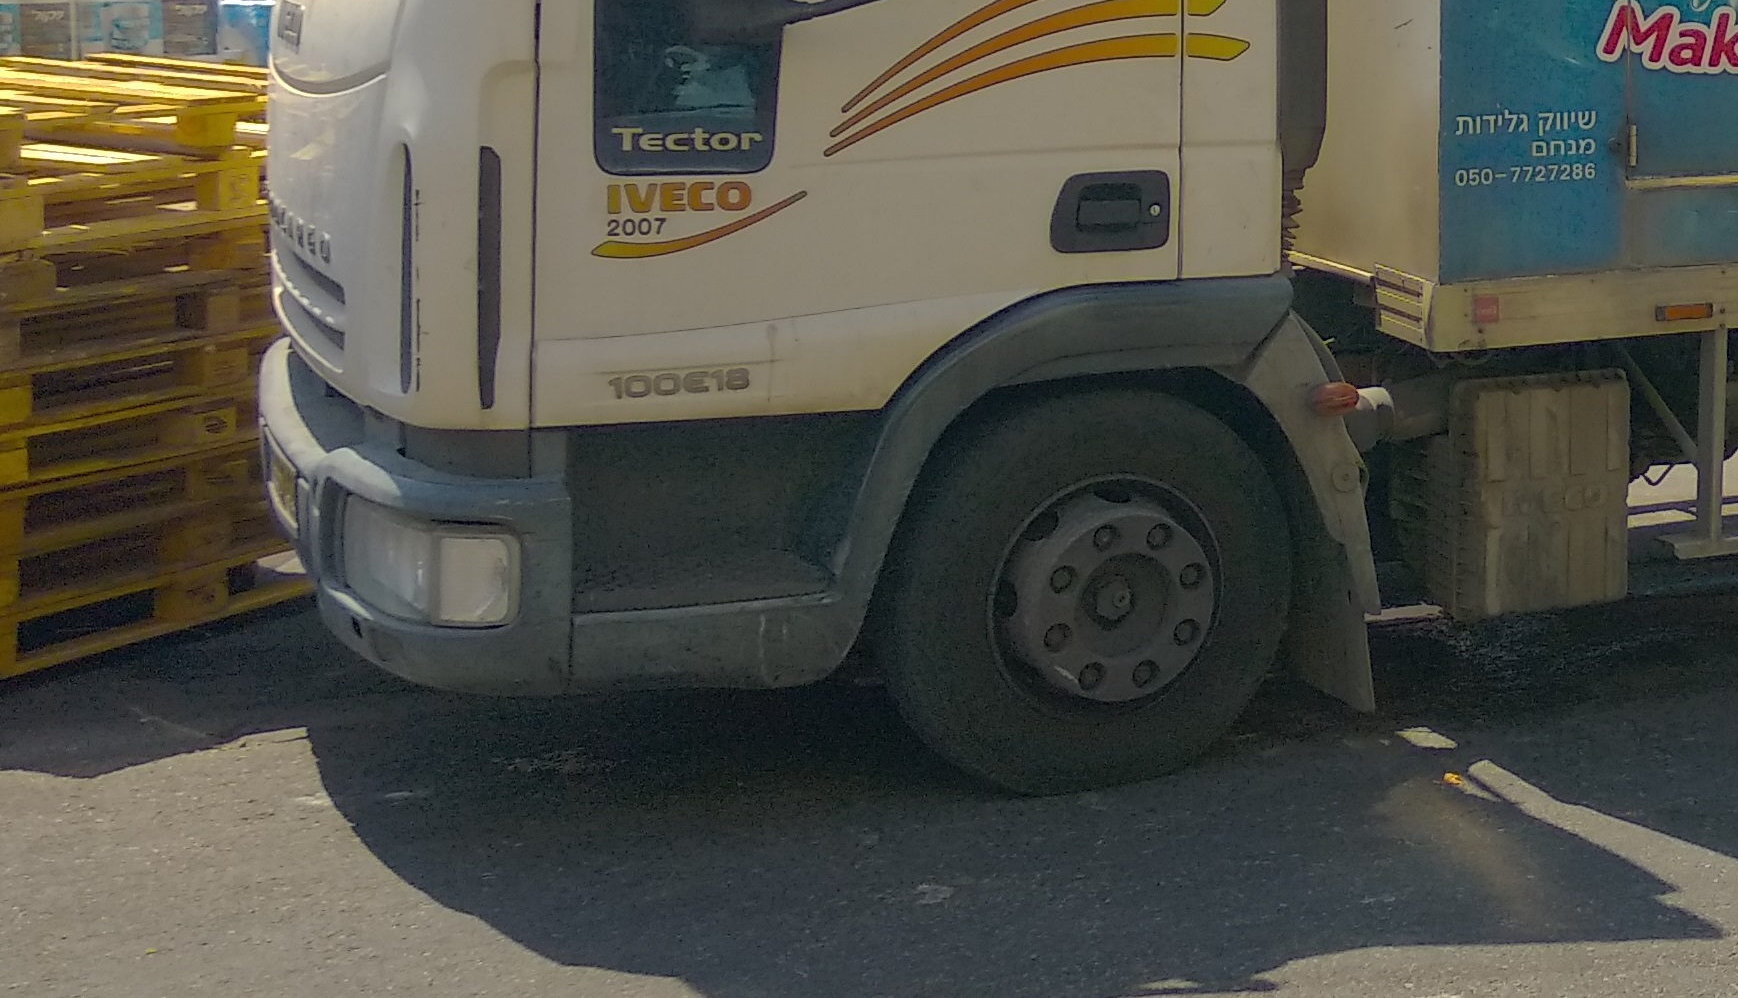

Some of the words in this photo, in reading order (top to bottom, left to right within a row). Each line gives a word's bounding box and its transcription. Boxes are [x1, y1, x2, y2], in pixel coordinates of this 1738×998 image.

[1455, 109, 1530, 136] גלידות
[1537, 110, 1596, 137] שיווק
[611, 127, 763, 152] Tector
[1531, 137, 1596, 157] מנחם
[1454, 162, 1596, 187] 050-7727286
[606, 181, 752, 215] IVECO
[606, 217, 667, 237] 2007
[607, 367, 751, 400] 100E18
